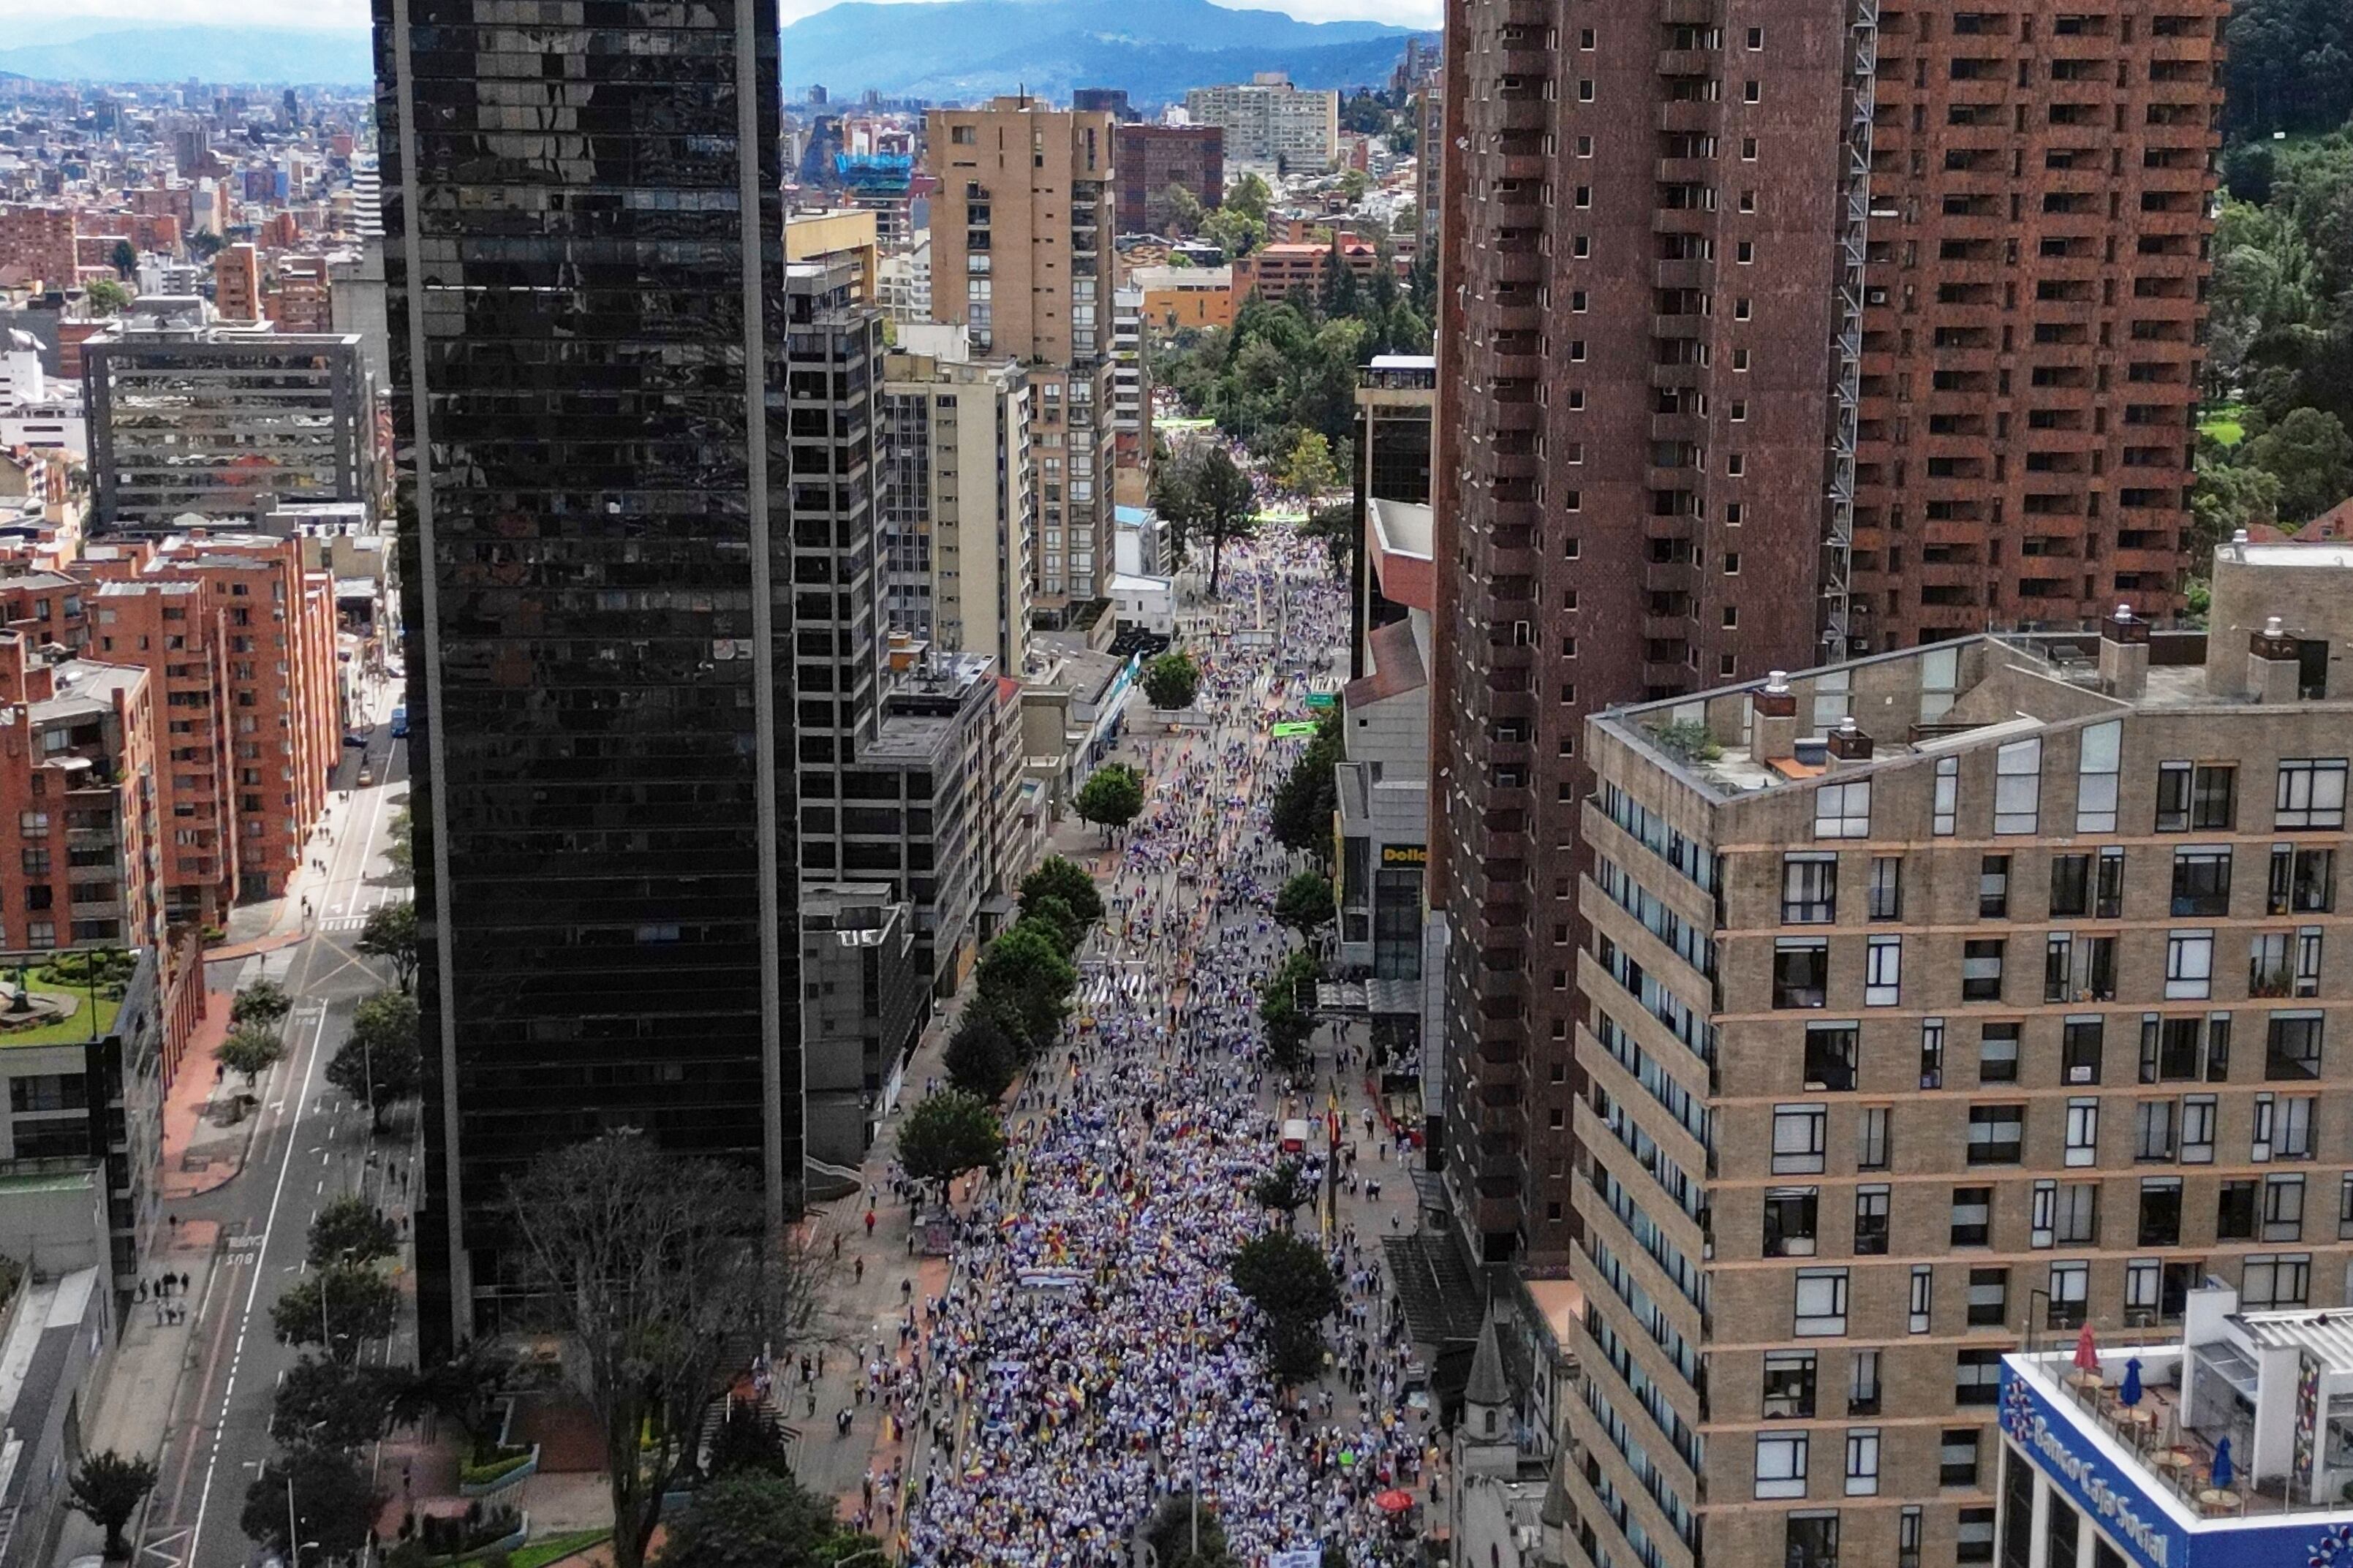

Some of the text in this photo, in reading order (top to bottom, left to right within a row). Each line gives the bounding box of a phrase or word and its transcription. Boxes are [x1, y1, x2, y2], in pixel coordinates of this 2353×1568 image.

[226, 1253, 254, 1265] BUS
[2033, 1414, 2168, 1568] Banco Caja Social
